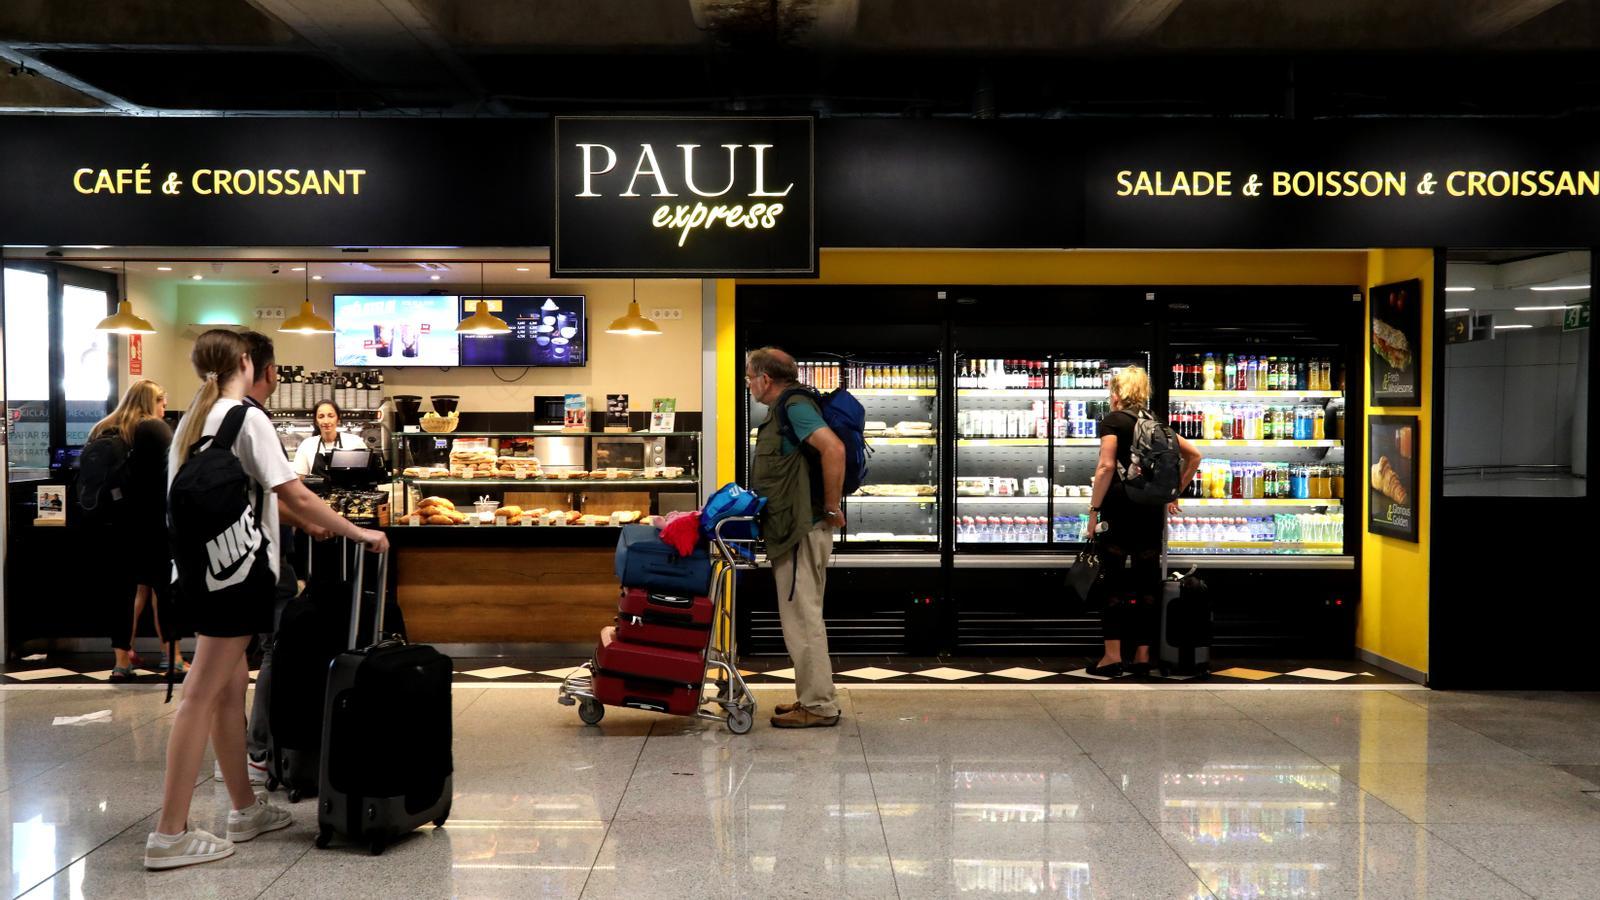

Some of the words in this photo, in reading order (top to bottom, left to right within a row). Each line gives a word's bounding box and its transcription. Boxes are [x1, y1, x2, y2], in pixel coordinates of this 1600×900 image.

[73, 163, 152, 195] CAFÉ
[161, 172, 183, 195] &
[191, 169, 367, 195] CROISSANT
[574, 143, 794, 198] PAUL
[1116, 170, 1232, 197] SALADE
[1242, 174, 1263, 197] &
[1272, 170, 1407, 197] BOISSON
[1416, 172, 1438, 196] &
[1445, 170, 1600, 197] CROISSAN
[651, 202, 785, 248] express
[205, 504, 263, 576] NIKE
